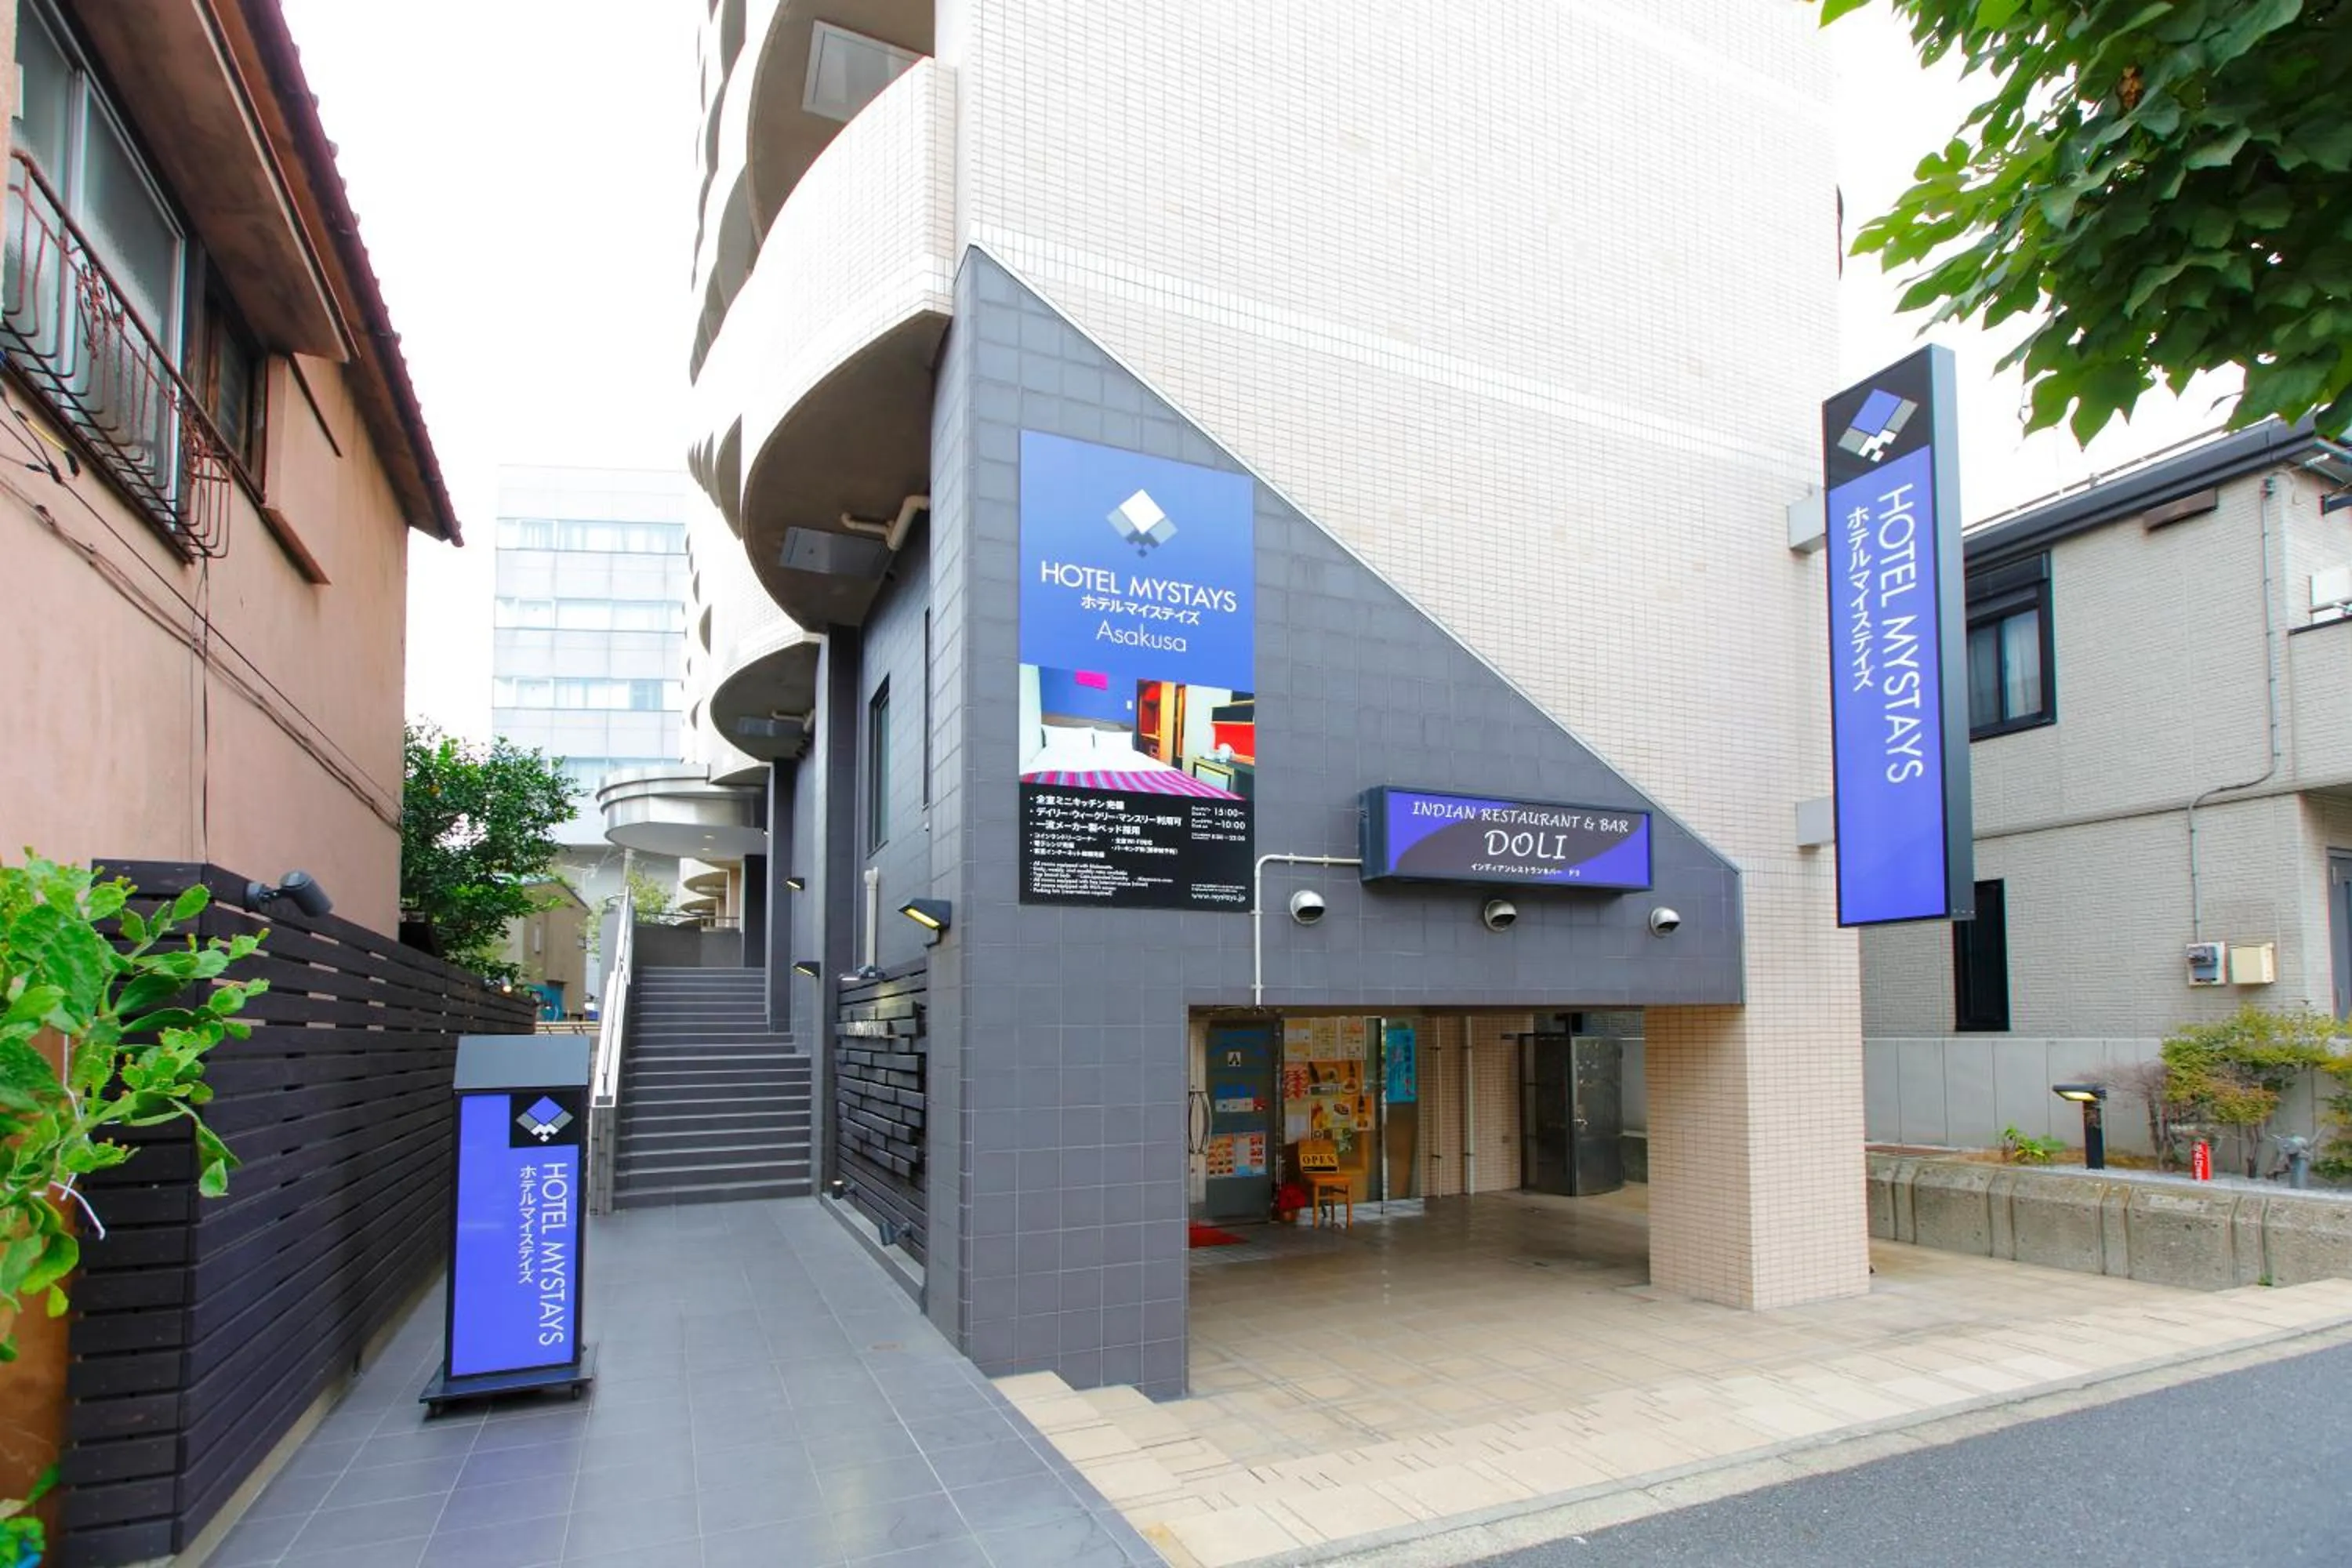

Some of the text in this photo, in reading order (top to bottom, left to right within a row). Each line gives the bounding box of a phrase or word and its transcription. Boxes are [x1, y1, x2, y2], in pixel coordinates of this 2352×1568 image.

[1041, 560, 1237, 612] HOTEL MYSTAYS
[1081, 594, 1202, 625] ホテルマイステイズ
[1846, 506, 1875, 692] ホテルマイステイズ
[1095, 619, 1187, 652] Asakusa
[1877, 483, 1923, 784] HOTEL MYSTAYS
[1412, 800, 1628, 833] INDIAN RESTAURANT & BAR
[1484, 829, 1567, 859] DOLI
[518, 1165, 537, 1284] ホテルマイステイズ
[539, 1162, 568, 1346] HOTEL MYSTAYS
